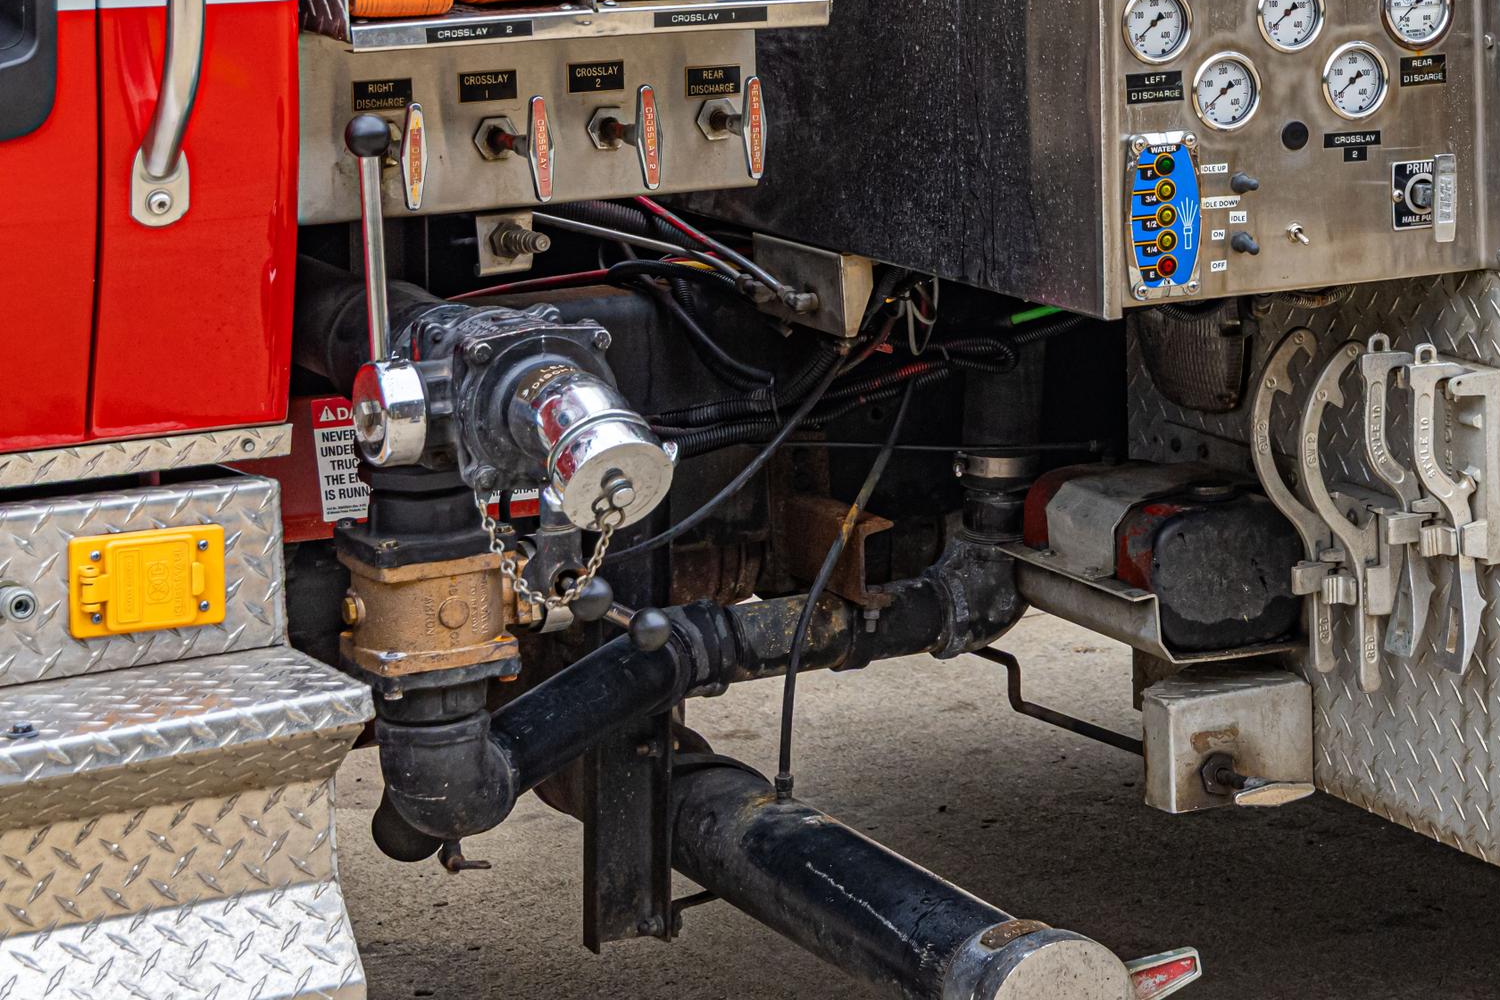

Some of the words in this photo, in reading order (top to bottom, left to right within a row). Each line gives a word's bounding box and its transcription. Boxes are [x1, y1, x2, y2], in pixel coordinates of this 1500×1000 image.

[1268, 0, 1278, 8] 100
[671, 11, 720, 23] CROSSLAY
[731, 11, 736, 20] 1
[437, 26, 488, 39] CROSSLAY
[505, 25, 513, 34] 2
[1412, 58, 1432, 67] REAR
[576, 66, 619, 78] CROSSLAY
[703, 70, 724, 80] REAR
[1403, 73, 1443, 83] DISCARGE
[464, 74, 509, 86] CROSSLAY
[596, 79, 601, 88] 2
[1144, 75, 1166, 84] LEFT
[368, 82, 395, 94] RIGHT
[690, 83, 735, 95] DISCHARGE
[751, 84, 759, 109] REAR
[1131, 89, 1180, 100] DISCHARGE
[356, 97, 405, 110] DISCHARGE
[645, 106, 655, 158] CROSSLAY
[536, 119, 548, 170] CROSSLAY
[752, 114, 761, 170] DISCHARGE
[1334, 134, 1375, 144] CROSSLAY
[1150, 144, 1177, 154] WATER
[1352, 150, 1358, 158] 2
[1406, 162, 1433, 175] PRIM
[1145, 195, 1157, 203] 3/4
[1203, 200, 1218, 208] IDLE
[1146, 220, 1158, 228] 1/2
[1230, 214, 1246, 222] IDLE
[1402, 215, 1420, 224] HALE
[1420, 214, 1432, 222] PU
[1146, 246, 1158, 254] 1/4
[321, 428, 357, 443] NEVER
[1370, 424, 1387, 465] STYLE
[1419, 436, 1436, 479] STYLE
[330, 457, 359, 471] TRUC
[324, 474, 346, 487] THE
[325, 489, 336, 501] IS
[339, 486, 371, 500] RUNN
[1319, 616, 1329, 641] RED
[1366, 636, 1376, 660] RED
